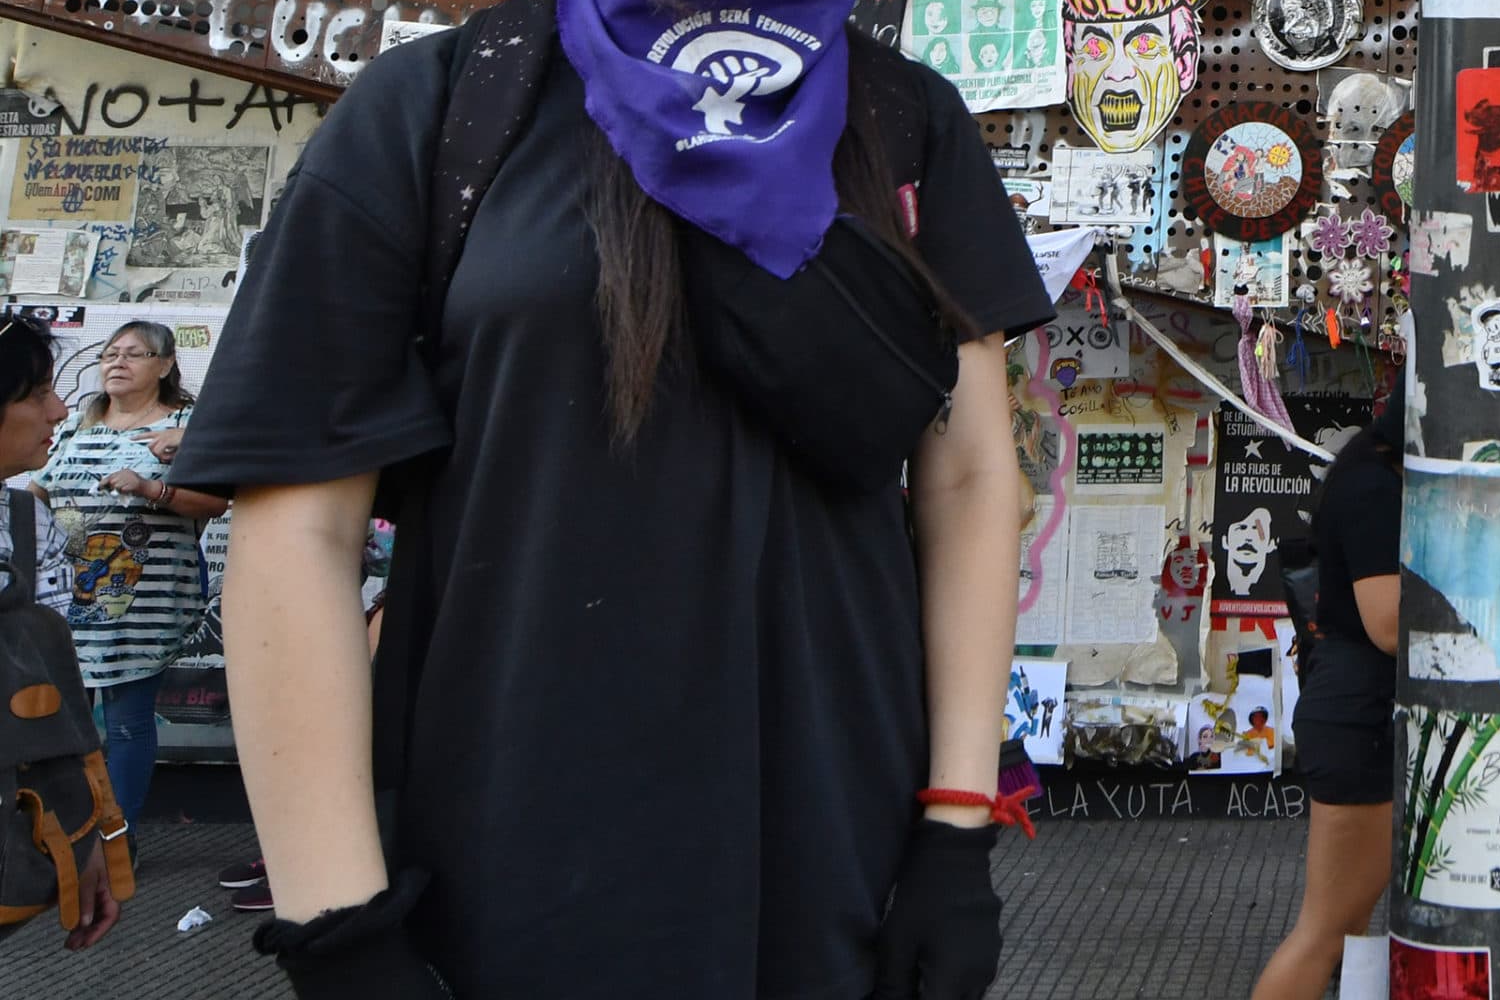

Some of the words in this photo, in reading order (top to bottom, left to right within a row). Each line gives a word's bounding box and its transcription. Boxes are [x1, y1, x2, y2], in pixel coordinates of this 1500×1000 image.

[646, 11, 712, 64] REVOLUCIÓN
[720, 8, 751, 25] SERÁ
[756, 14, 822, 51] FEMINISTA
[31, 124, 56, 136] VIDAS
[1224, 463, 1230, 473] A
[1231, 463, 1247, 473] LAS
[1248, 463, 1270, 474] FILAS
[1271, 464, 1282, 474] DE
[1225, 477, 1239, 493] LA
[1242, 474, 1311, 495] REVOLUCIÓN
